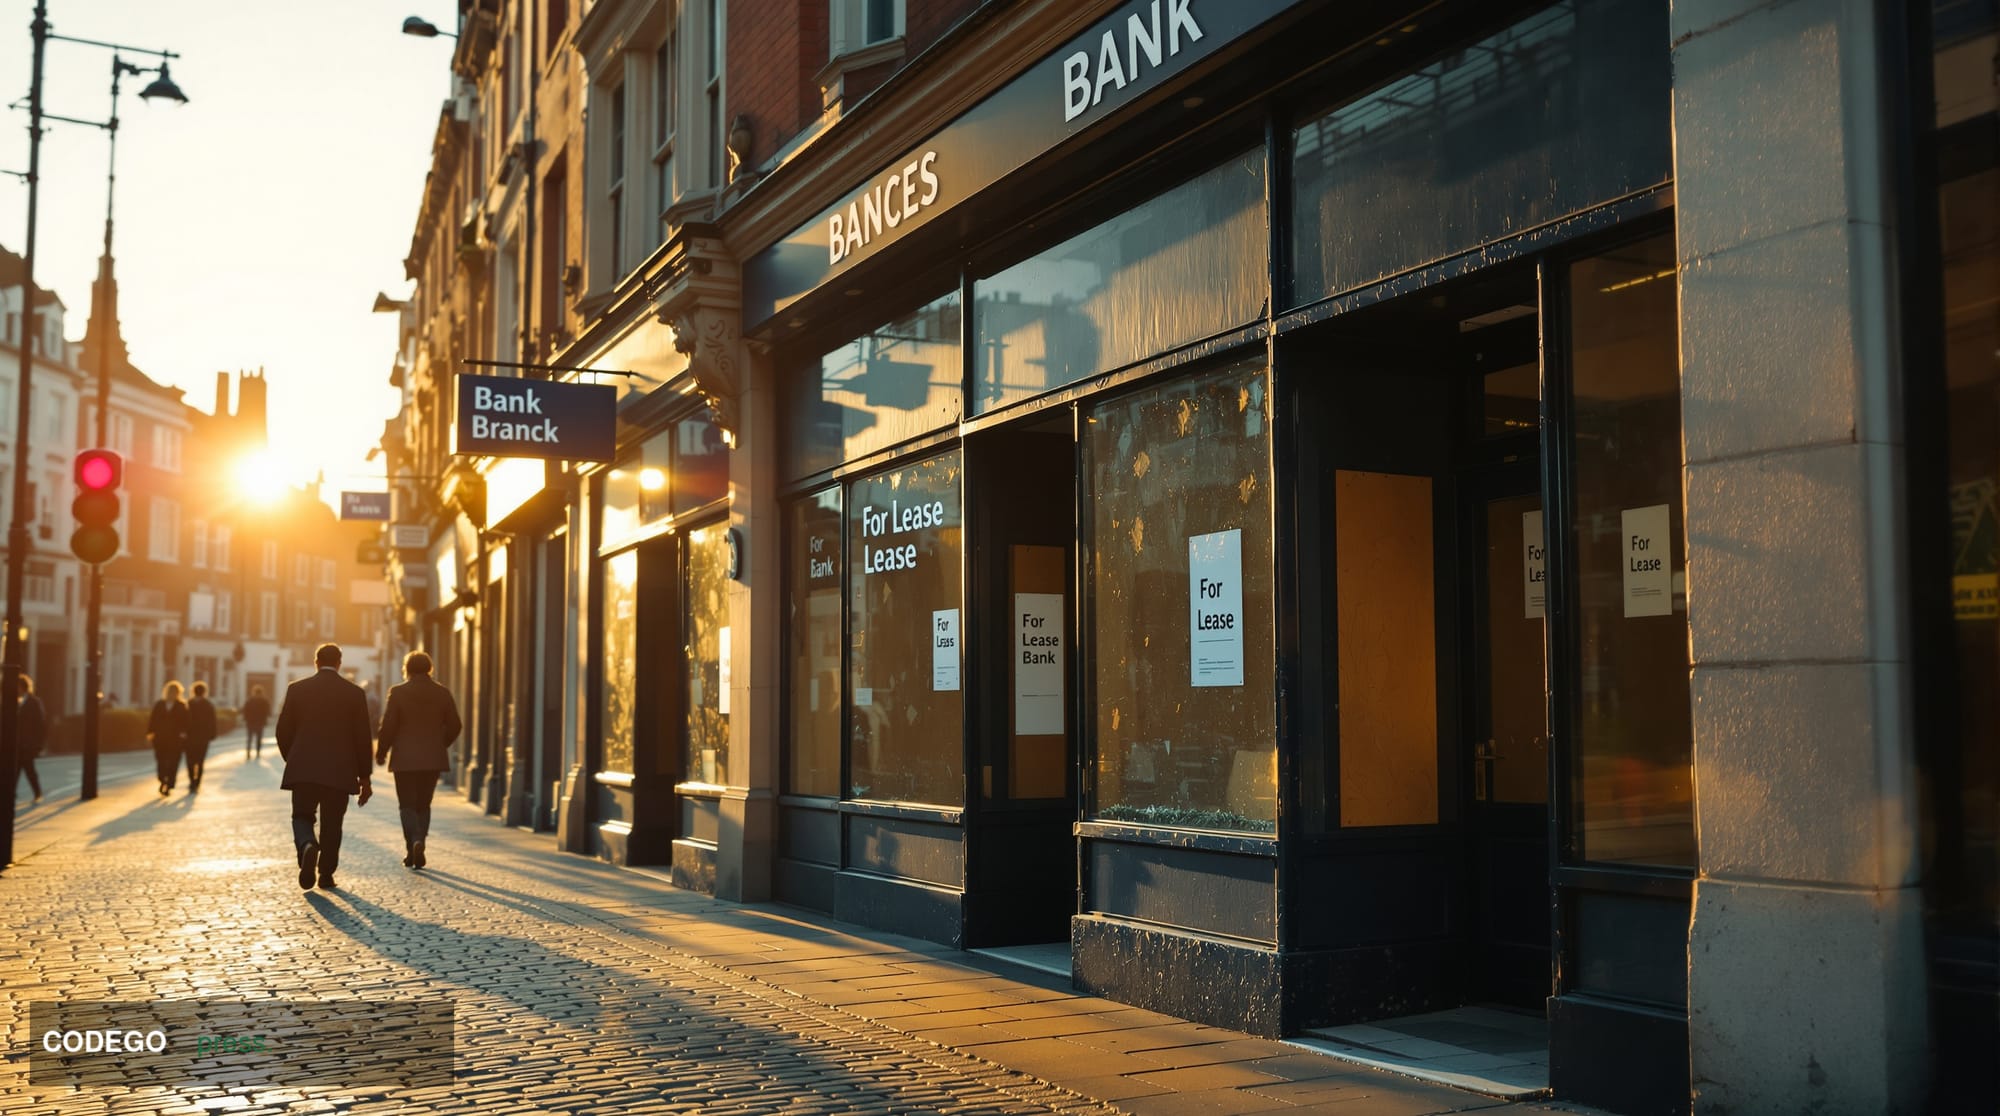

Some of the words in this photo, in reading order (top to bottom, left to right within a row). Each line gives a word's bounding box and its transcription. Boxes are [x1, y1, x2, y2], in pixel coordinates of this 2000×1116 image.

[1063, 0, 1204, 123] BANK
[828, 151, 940, 266] BANCES
[474, 386, 543, 415] Bank
[472, 414, 560, 443] Branck
[862, 505, 889, 537] For
[892, 500, 944, 533] Lease
[810, 535, 824, 553] For
[1528, 545, 1545, 560] For
[1631, 535, 1650, 551] For
[864, 543, 917, 574] Lease
[1630, 557, 1661, 572] Lease
[1200, 578, 1223, 599] For
[937, 617, 949, 632] For
[1022, 614, 1045, 628] For
[1198, 609, 1234, 630] Lease
[1022, 633, 1059, 647] Lease
[1022, 651, 1056, 664] Bank
